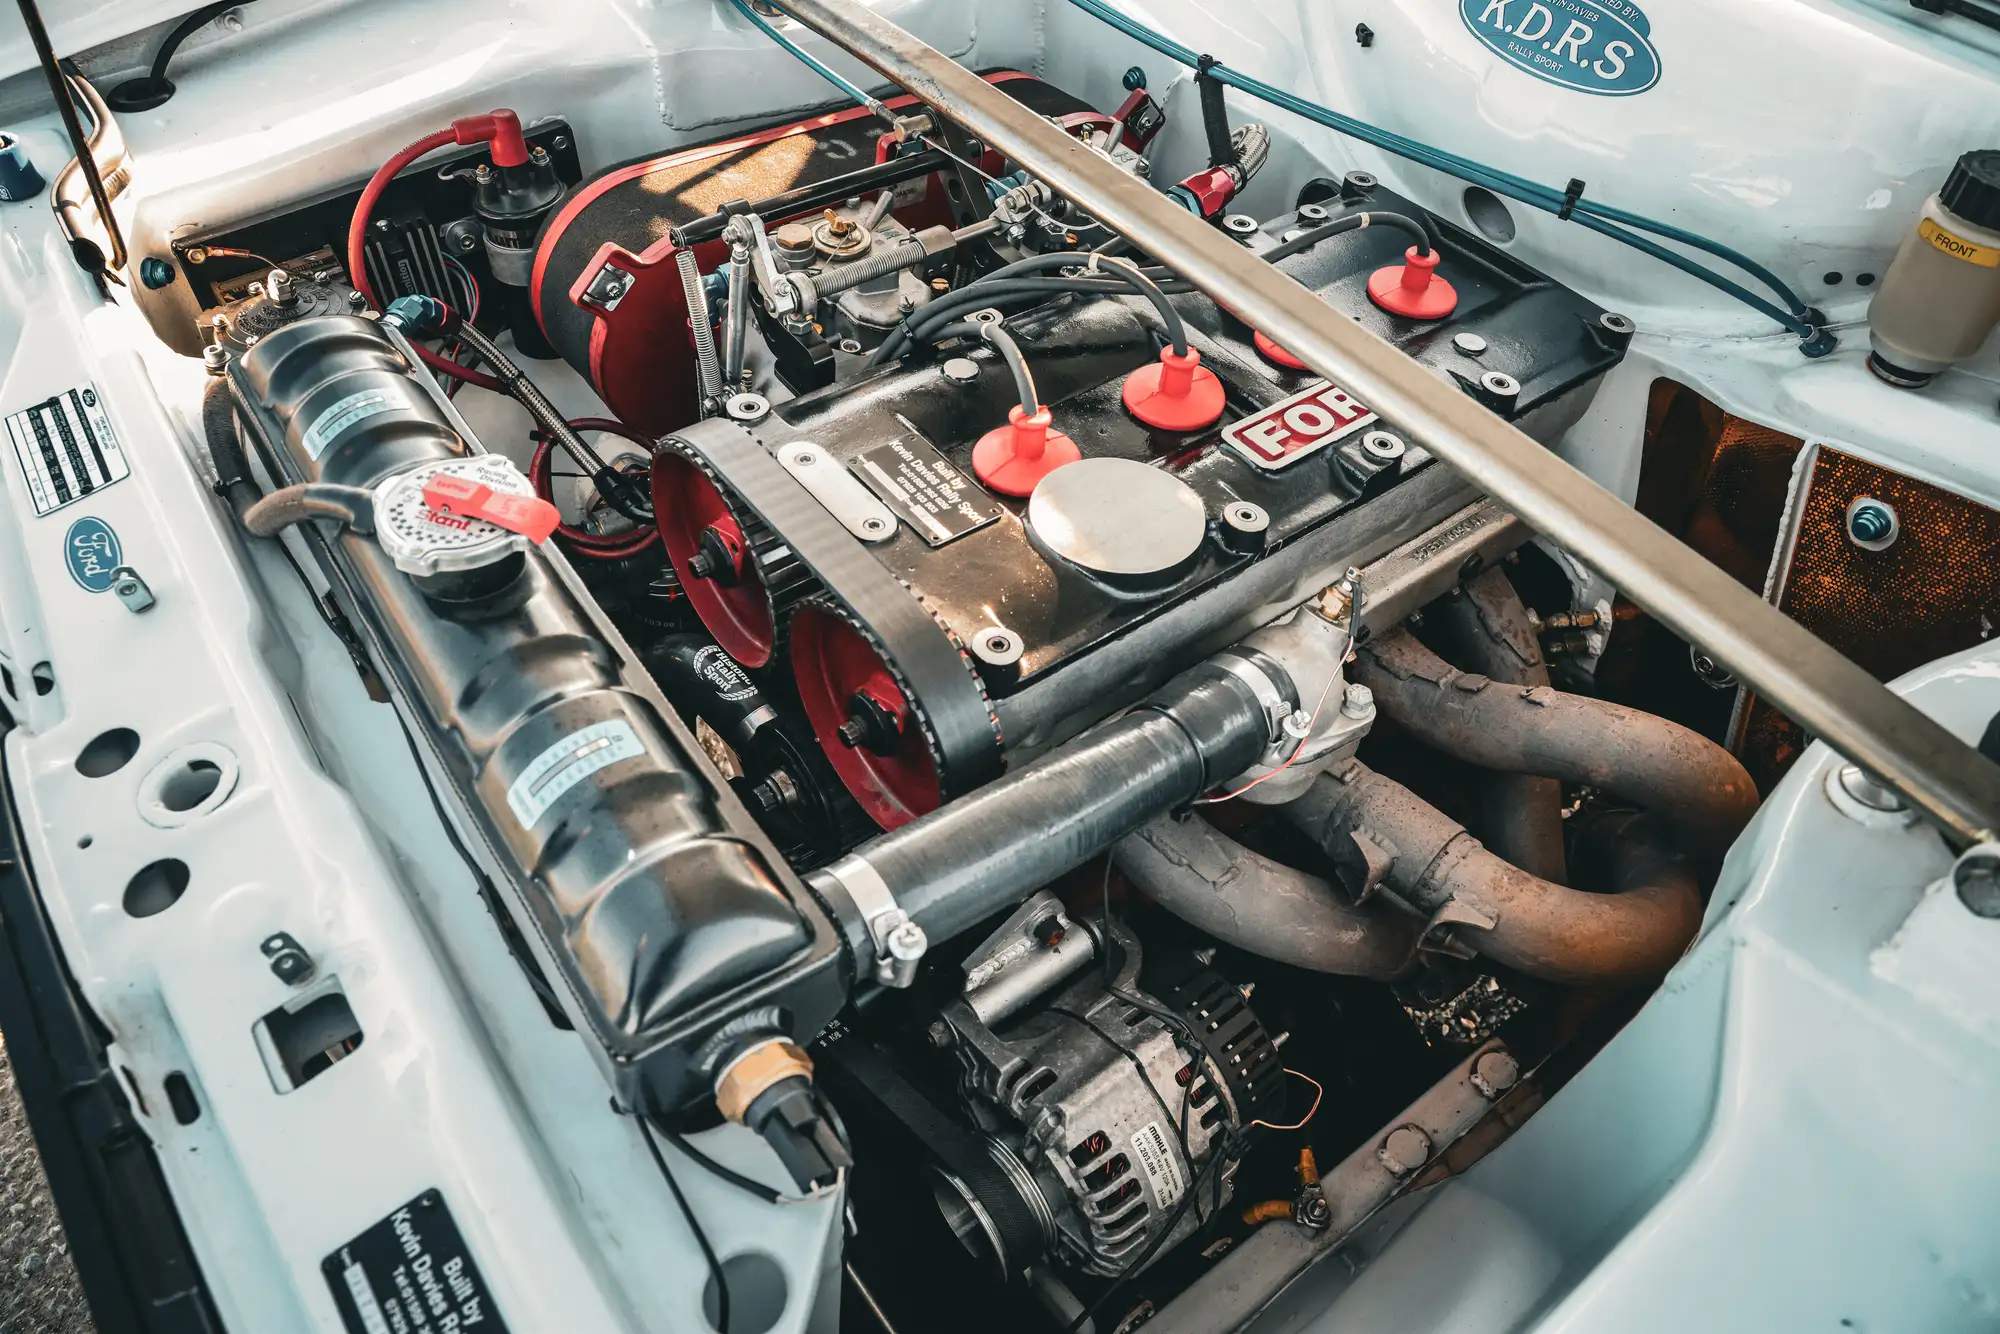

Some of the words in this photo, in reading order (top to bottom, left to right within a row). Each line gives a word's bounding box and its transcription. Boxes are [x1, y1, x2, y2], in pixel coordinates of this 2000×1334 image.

[1547, 0, 1565, 9] VIN
[1567, 4, 1599, 22] DAVIES
[1622, 6, 1639, 21] BY:
[1478, 0, 1635, 80] K.D.R.S
[1507, 41, 1534, 59] RALLY
[1534, 54, 1564, 73] SPORT
[1934, 233, 1978, 258] FRONT
[1242, 387, 1369, 457] FOR
[476, 466, 508, 479] Racing
[479, 474, 517, 489] Division
[889, 440, 914, 462] Kevin
[910, 459, 940, 485] Davies
[937, 482, 962, 504] Rally
[957, 501, 987, 524] Sport
[931, 460, 957, 483] Built
[950, 477, 966, 490] by
[914, 491, 927, 504] 103
[924, 501, 939, 514] 903
[73, 532, 113, 578] Ford
[703, 665, 732, 692] Sport
[712, 660, 740, 685] Rally
[1149, 1126, 1168, 1155] MAHLE
[390, 1207, 422, 1259] Kevin
[411, 1253, 449, 1316] Davies
[442, 1256, 475, 1302] Built
[462, 1295, 484, 1326] by
